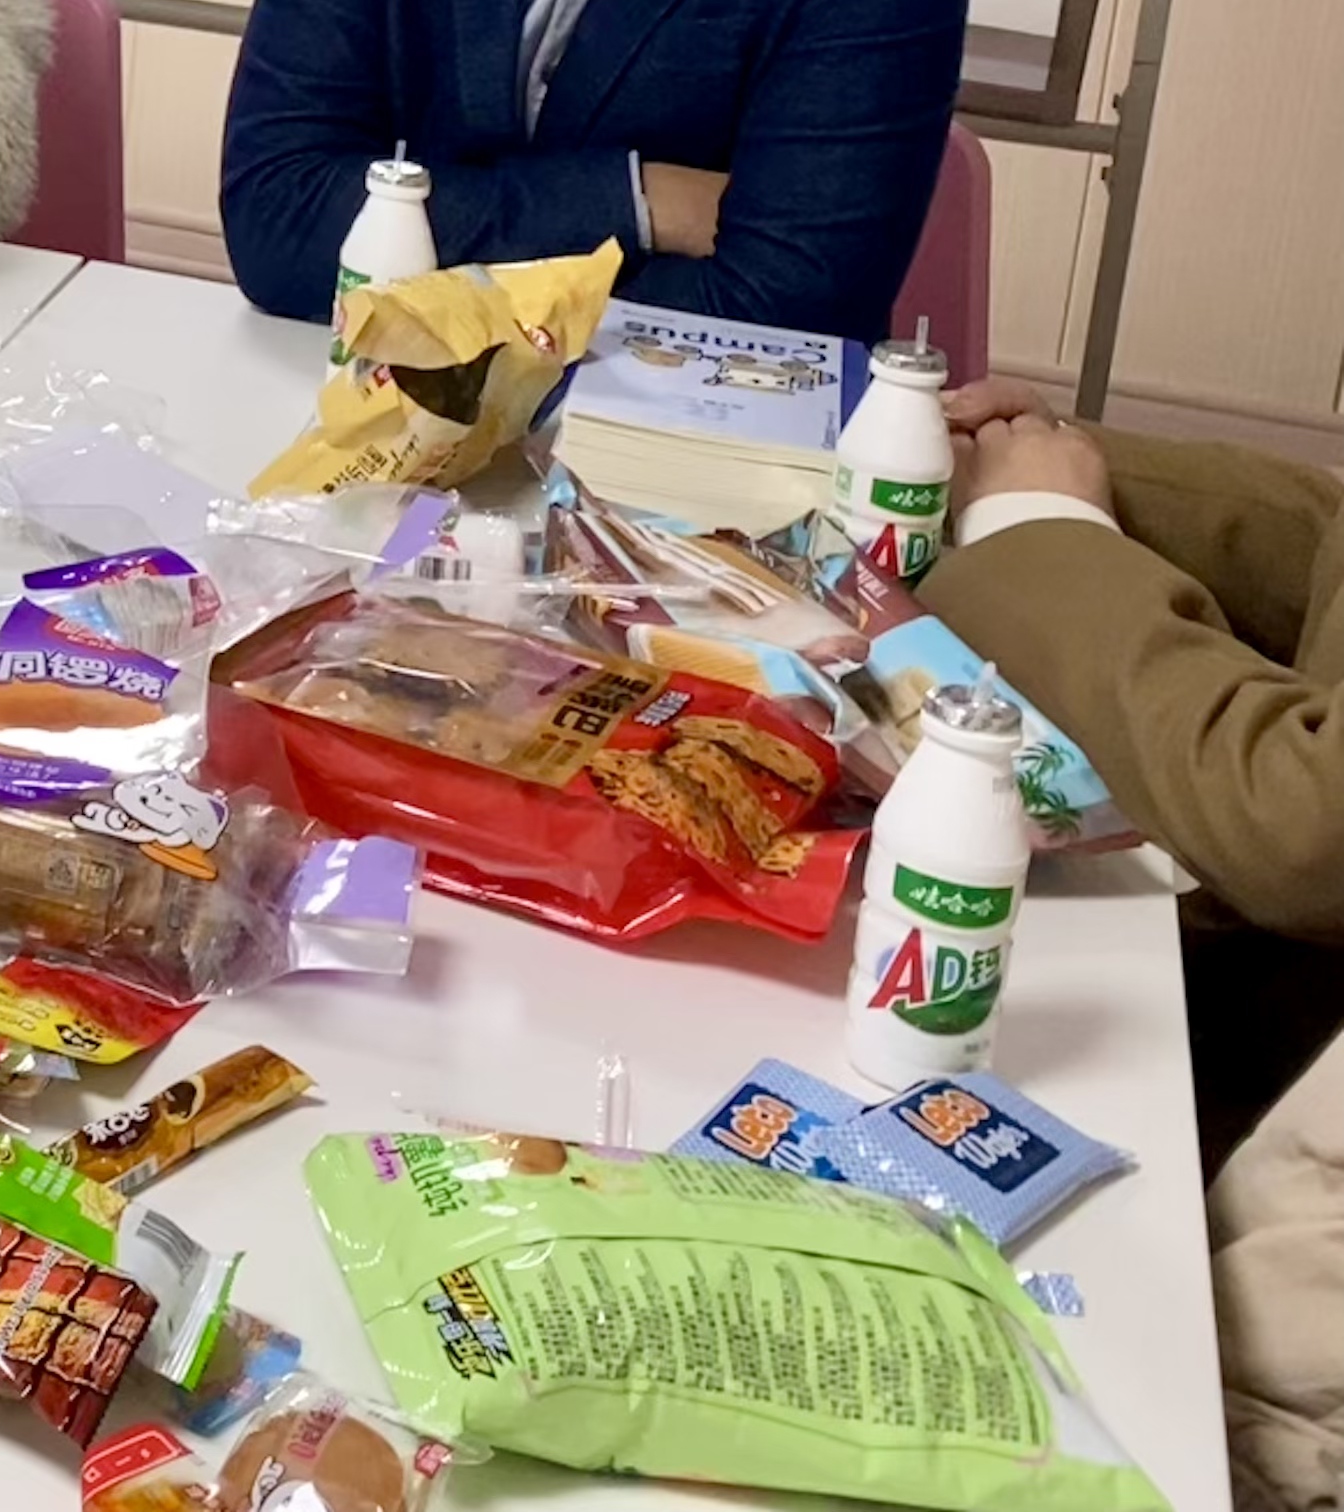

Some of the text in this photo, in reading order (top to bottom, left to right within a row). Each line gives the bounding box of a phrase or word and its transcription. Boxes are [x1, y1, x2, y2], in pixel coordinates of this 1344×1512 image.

[624, 321, 827, 364] Campus
[908, 883, 996, 918] 娃哈哈
